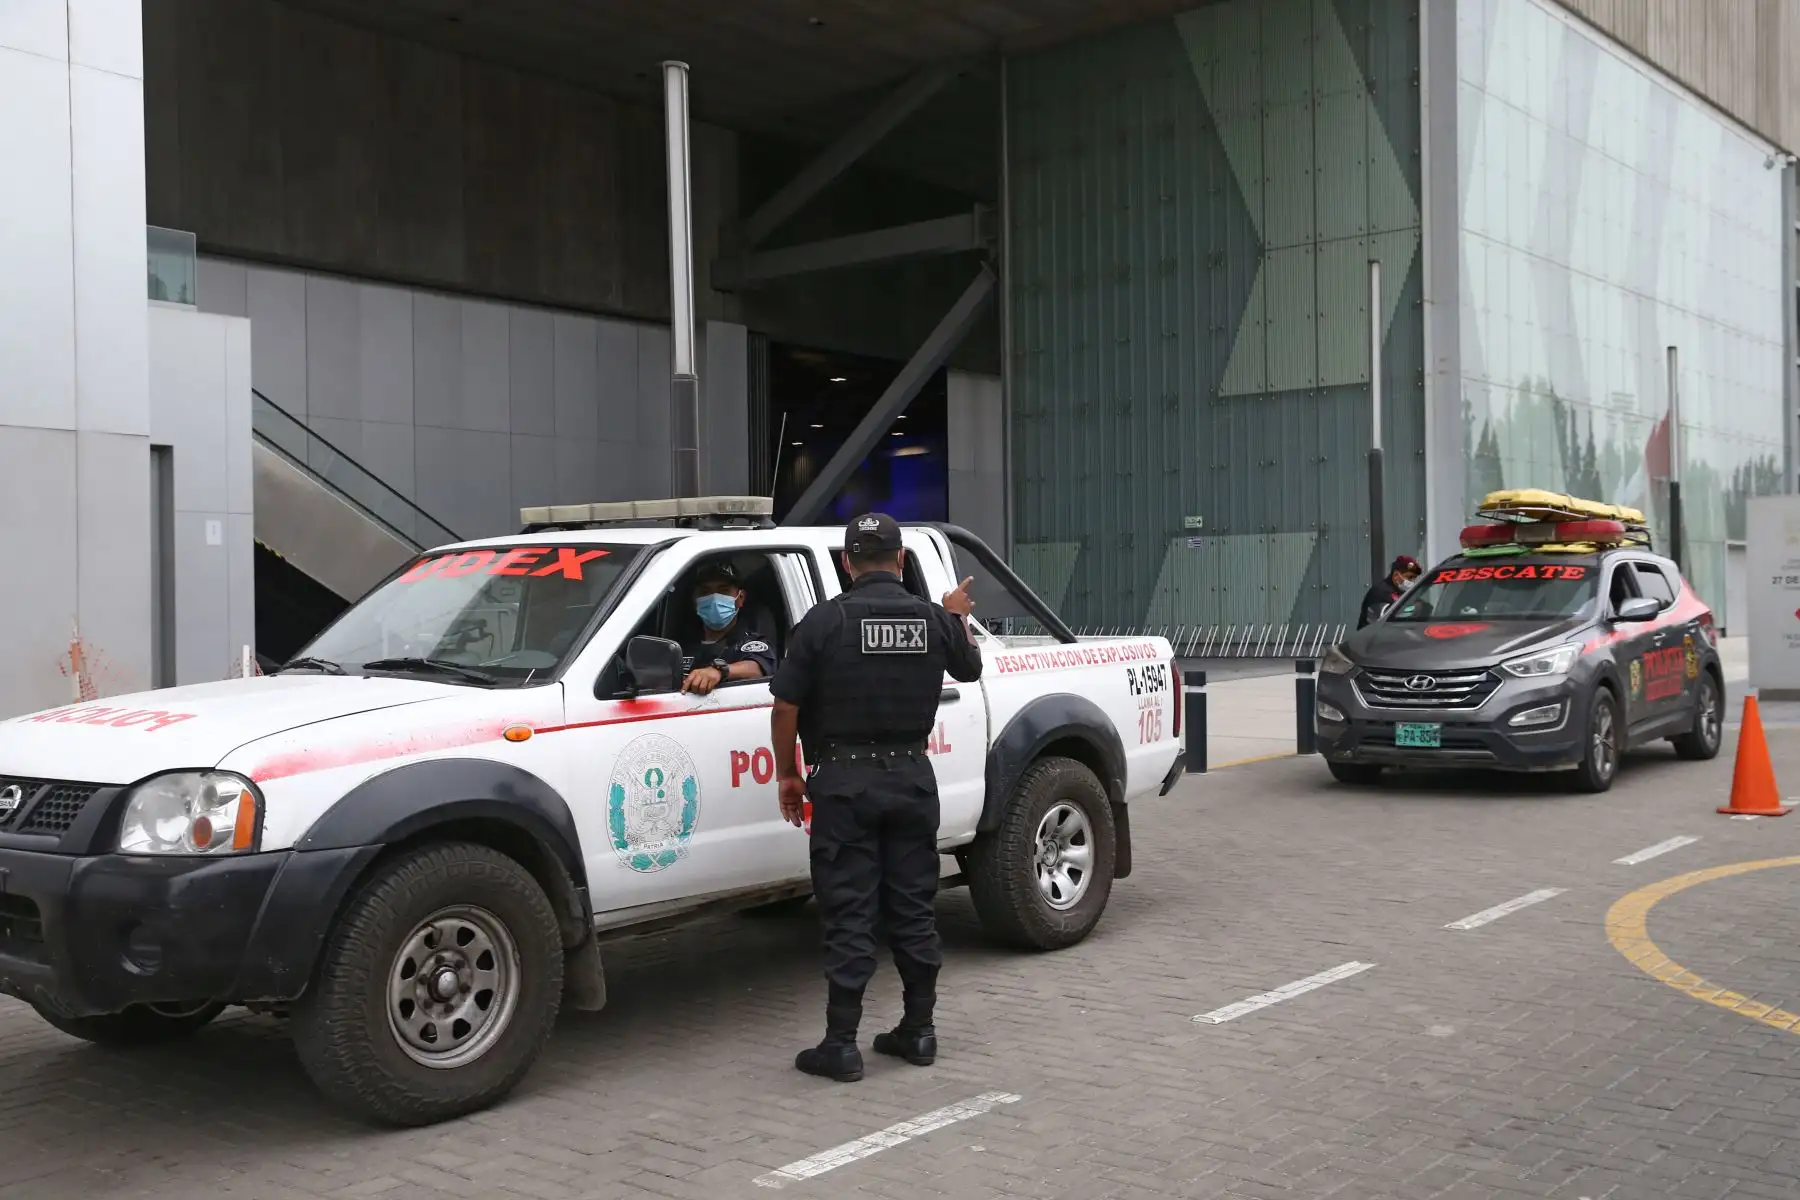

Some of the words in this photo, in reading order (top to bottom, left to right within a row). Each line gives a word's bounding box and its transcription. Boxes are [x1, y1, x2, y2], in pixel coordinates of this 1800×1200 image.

[400, 547, 610, 584] UDEX
[1432, 565, 1586, 585] RESCATE
[865, 624, 924, 648] UDEX
[995, 651, 1084, 673] DESACTIVACION
[1084, 648, 1099, 665] DE
[1099, 643, 1157, 663] EXPLOSIVOS
[1127, 663, 1168, 696] PL-15947
[1138, 708, 1163, 744] 105
